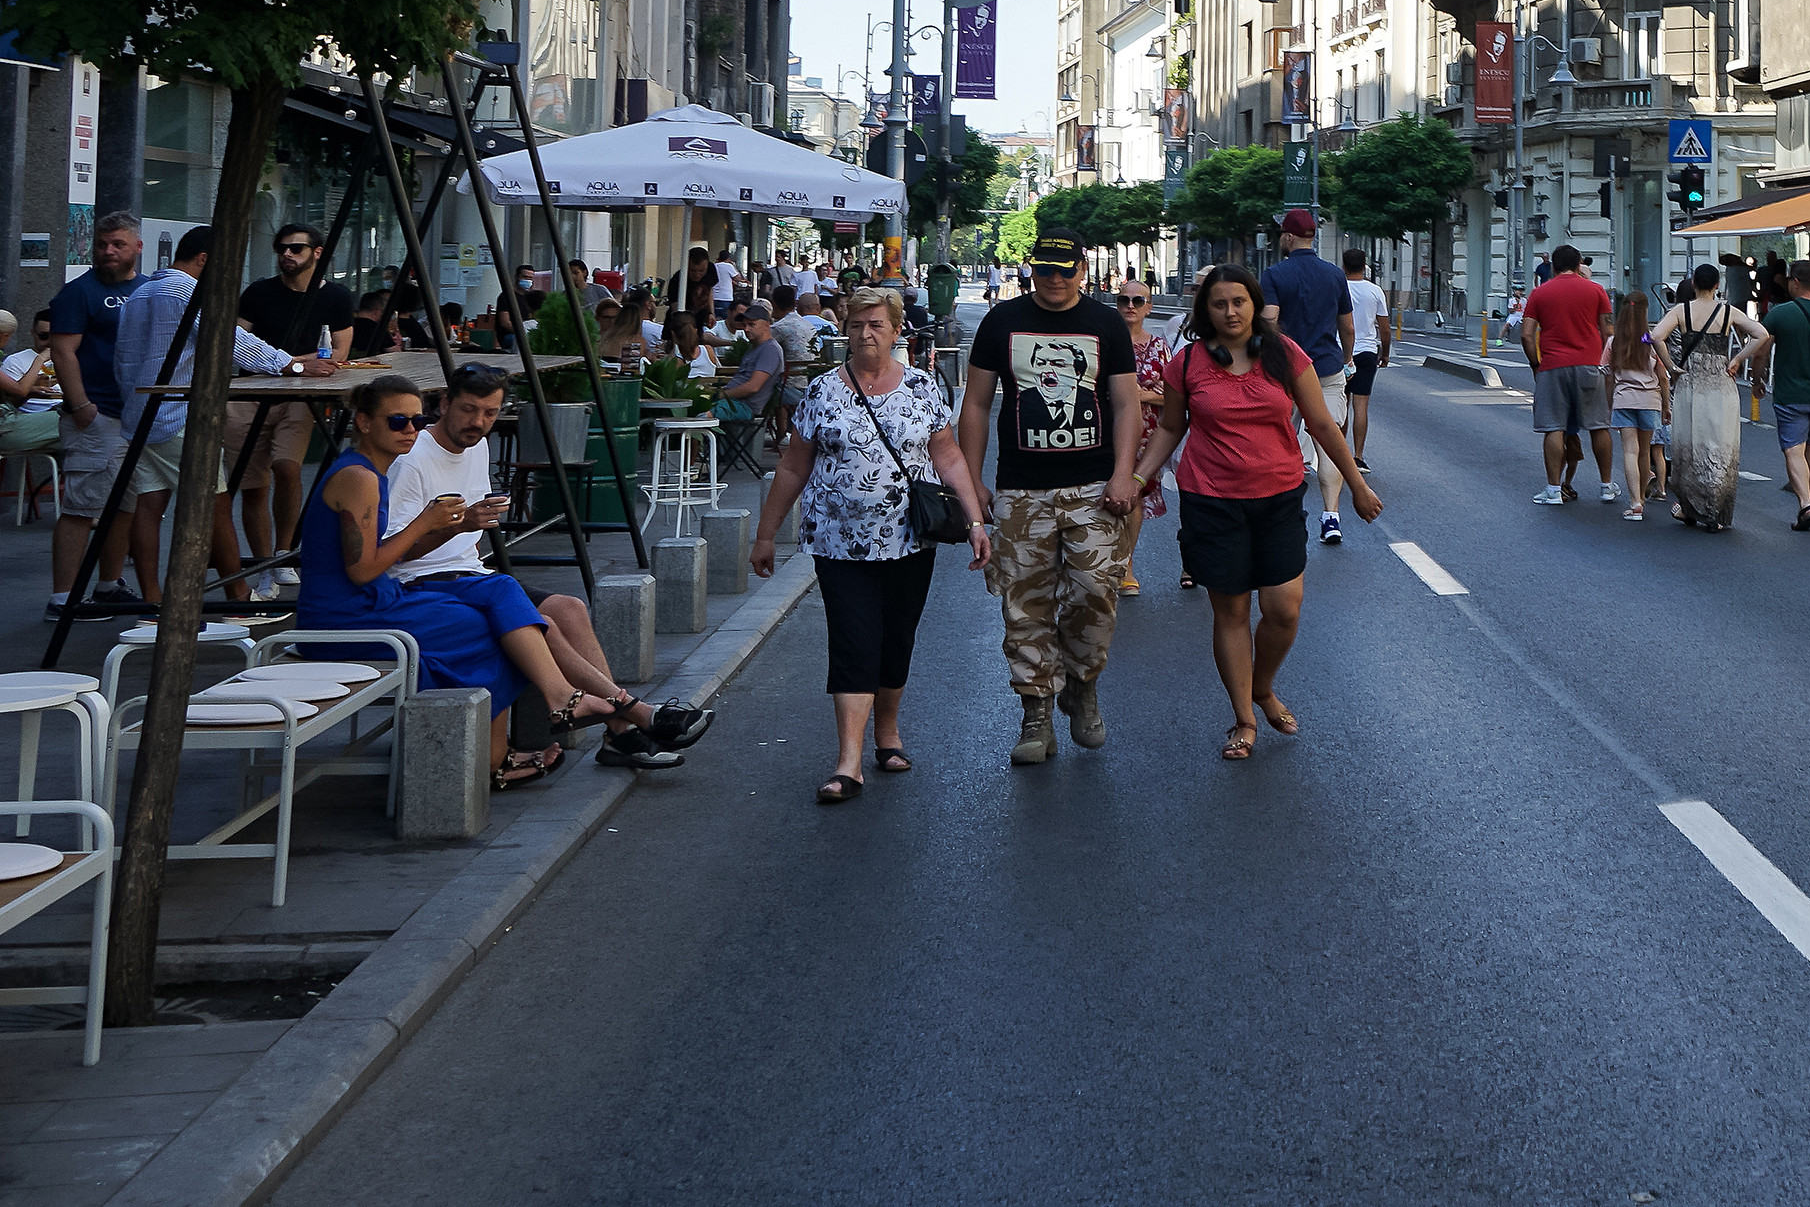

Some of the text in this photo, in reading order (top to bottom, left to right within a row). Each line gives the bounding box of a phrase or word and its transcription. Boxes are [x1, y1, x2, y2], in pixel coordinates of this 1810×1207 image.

[667, 151, 729, 162] AQUA
[586, 181, 620, 191] AQUA
[683, 183, 716, 194] AQUA
[776, 191, 810, 202] AQUA
[869, 198, 899, 208] AQUA
[1027, 426, 1095, 449] HOE!
